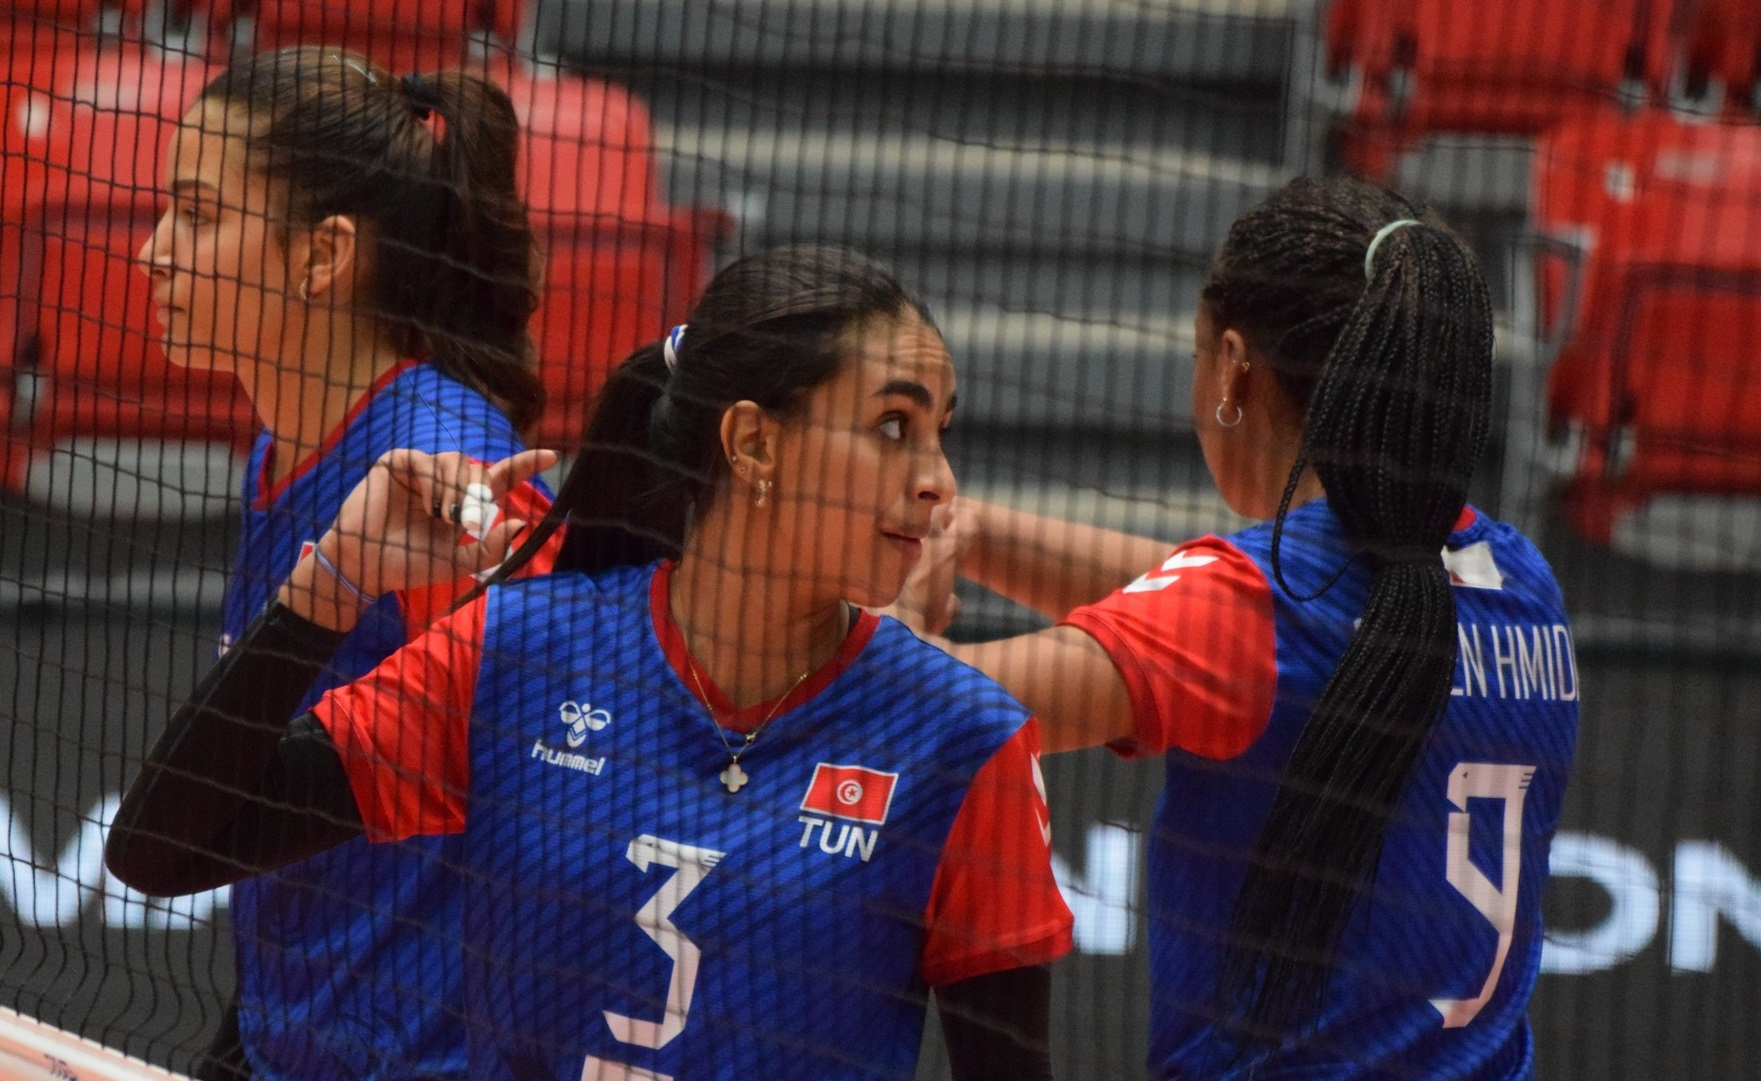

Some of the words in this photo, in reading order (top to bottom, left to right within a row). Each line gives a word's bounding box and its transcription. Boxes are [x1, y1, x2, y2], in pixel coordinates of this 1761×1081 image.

[1491, 624, 1580, 701] HMID
[531, 739, 605, 776] hummel
[798, 815, 878, 862] TUN
[1428, 762, 1537, 1028] 9
[603, 834, 727, 1050] 3
